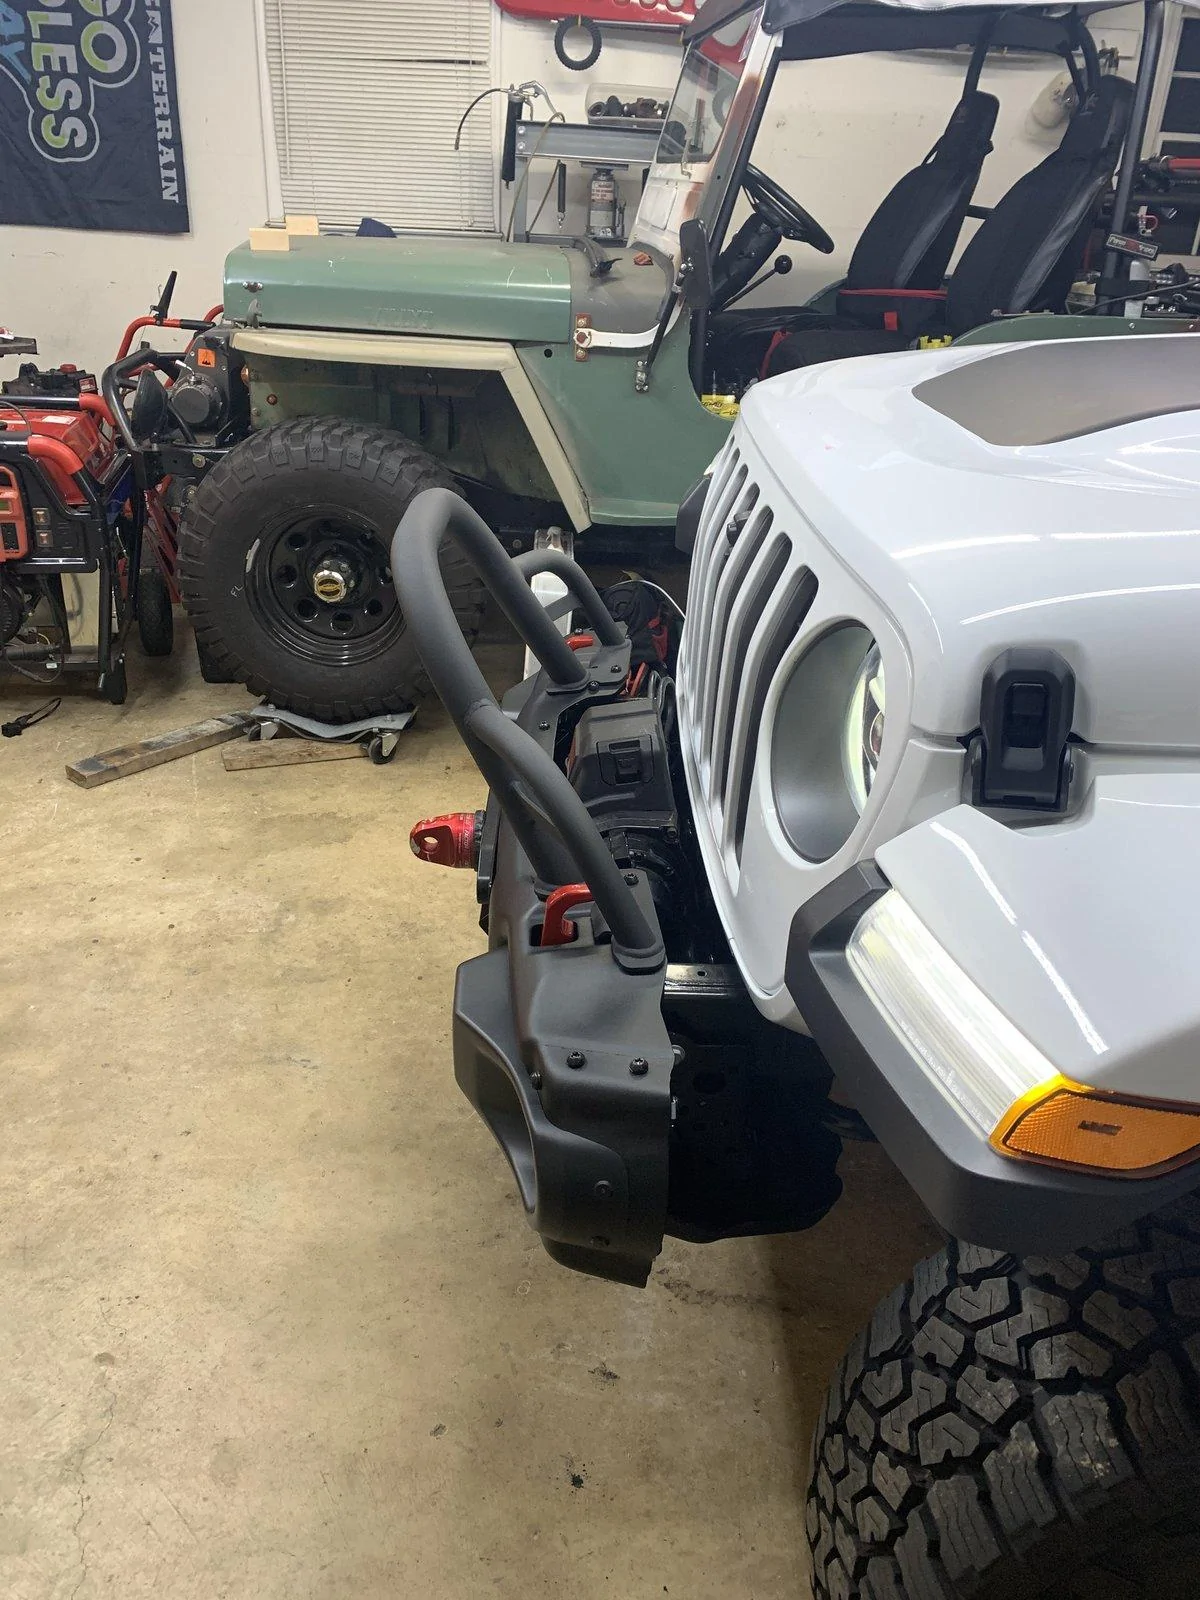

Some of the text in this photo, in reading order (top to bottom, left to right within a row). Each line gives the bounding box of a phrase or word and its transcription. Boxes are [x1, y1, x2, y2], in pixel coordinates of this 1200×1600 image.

[27, 0, 88, 149] LESS
[79, 0, 128, 73] O
[149, 47, 179, 203] TERRAIN
